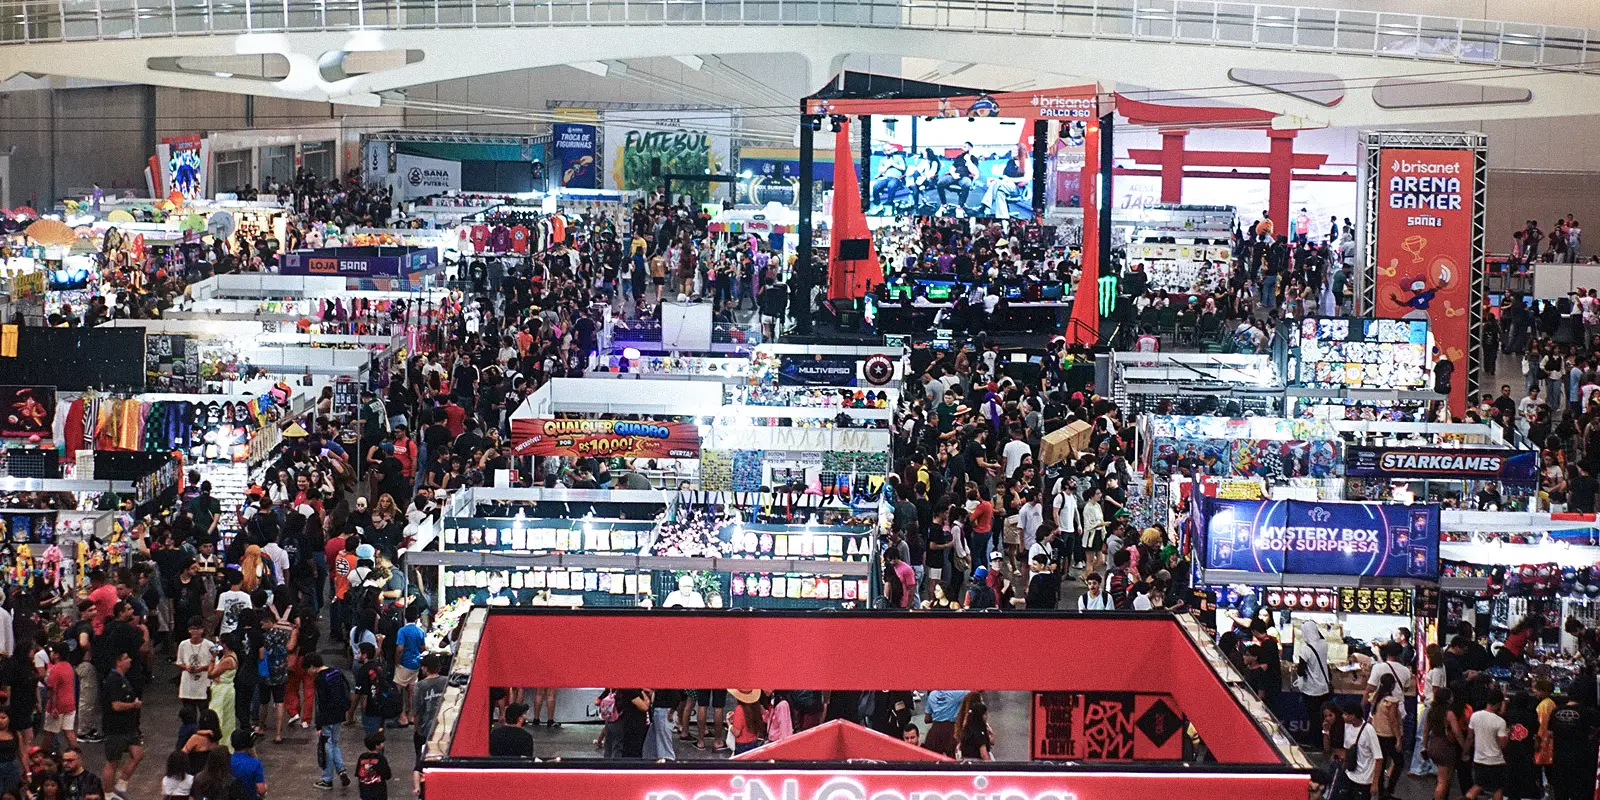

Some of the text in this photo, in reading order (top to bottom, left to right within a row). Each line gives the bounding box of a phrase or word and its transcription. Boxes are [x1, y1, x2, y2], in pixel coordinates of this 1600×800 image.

[1041, 108, 1070, 116] PALCO
[556, 140, 592, 149] FIGURINHAS
[561, 133, 580, 141] TROCA
[625, 129, 711, 155] FUTEBOL
[1401, 160, 1460, 174] brisanet
[1390, 176, 1461, 193] ARENA
[1389, 193, 1462, 210] GAMER
[1407, 217, 1436, 227] SANA
[310, 260, 368, 272] LOJA SANA
[543, 420, 670, 438] QUALQUER QUADRO
[559, 439, 573, 447] POR
[1382, 455, 1501, 471] STARKGAMES
[1260, 526, 1338, 541] MYSTERY
[1341, 529, 1379, 543] BOX
[1261, 538, 1380, 554] BOX SURPRESA
